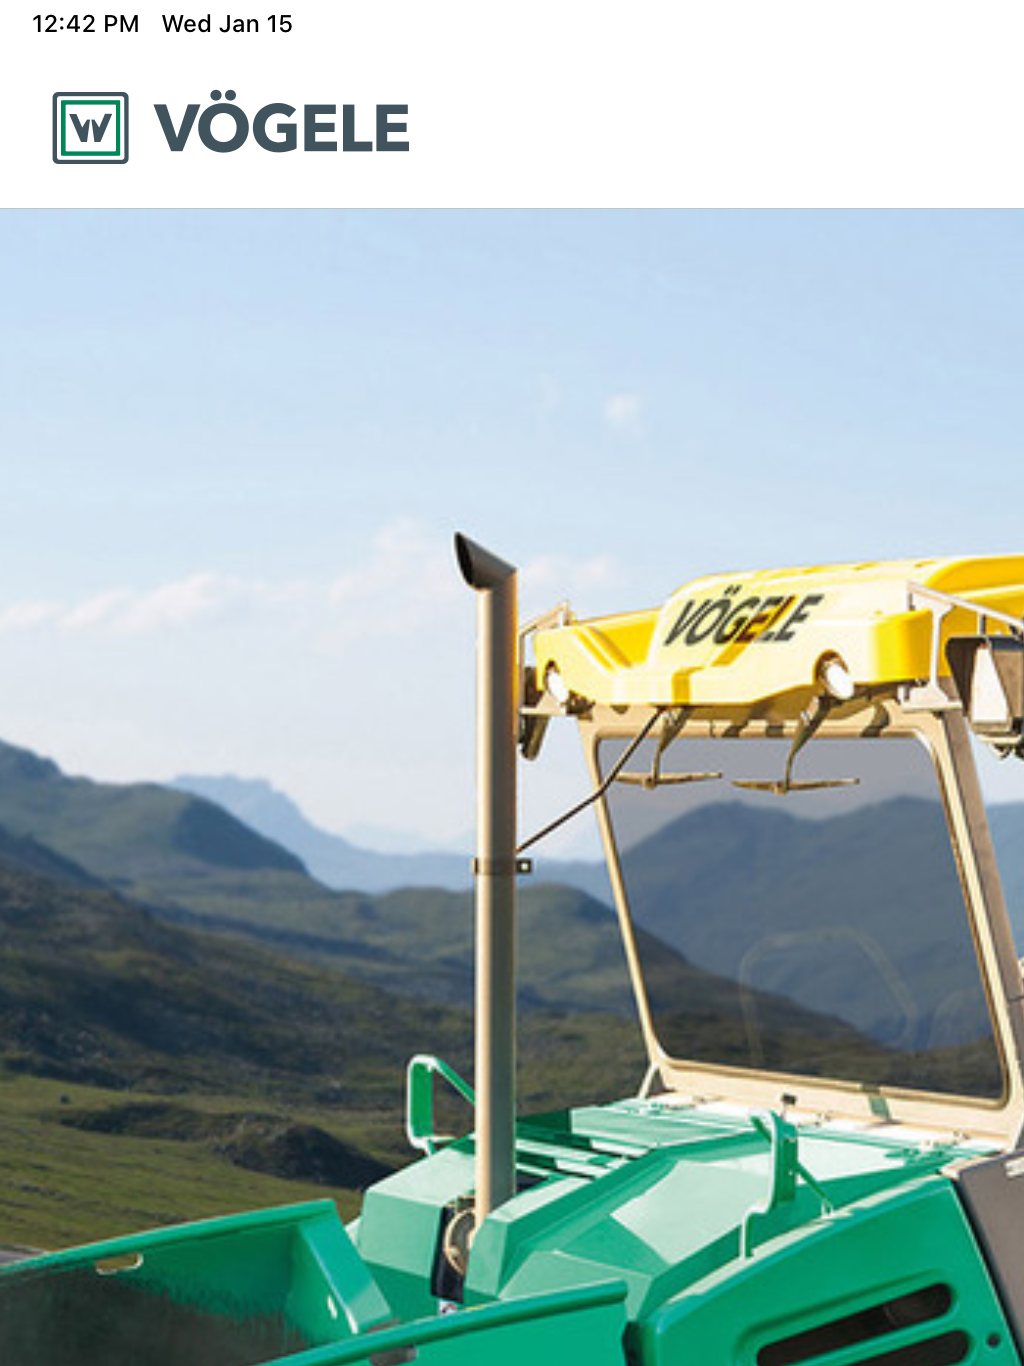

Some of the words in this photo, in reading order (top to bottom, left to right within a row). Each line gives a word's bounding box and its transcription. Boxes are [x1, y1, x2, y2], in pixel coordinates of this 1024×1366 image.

[33, 14, 95, 33] 12:42
[104, 14, 139, 33] PM
[161, 13, 211, 33] Wed
[218, 14, 259, 34] Jan
[267, 14, 293, 34] 15
[153, 89, 410, 154] VÖGELE
[664, 585, 825, 646] VÖGELE
